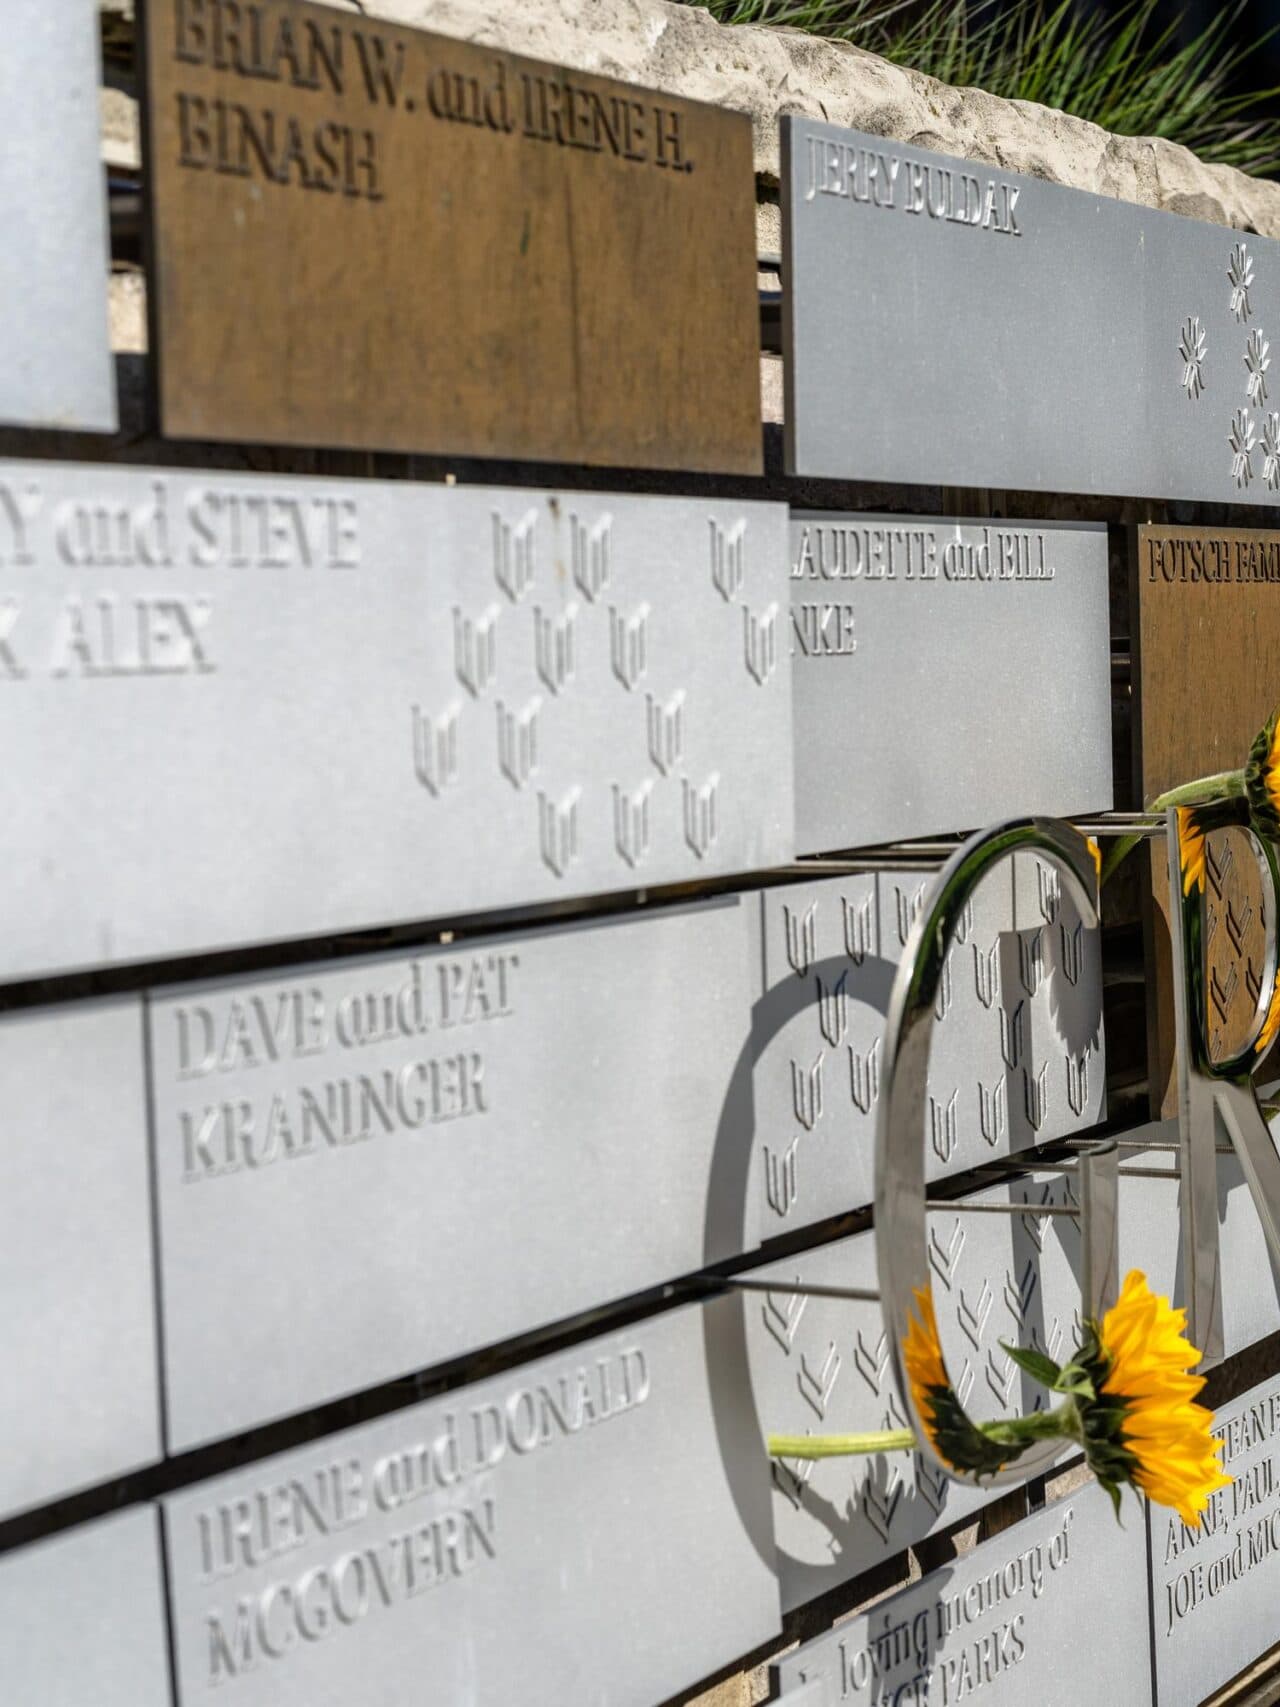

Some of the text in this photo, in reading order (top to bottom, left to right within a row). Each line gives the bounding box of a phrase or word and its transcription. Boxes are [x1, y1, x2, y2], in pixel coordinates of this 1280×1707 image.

[174, 0, 343, 96] BRIAN
[427, 59, 516, 135] and
[520, 72, 647, 163] IRENE
[176, 91, 385, 203] BINASH
[805, 135, 1023, 237] JERRY BULDAK
[55, 480, 174, 568] and
[184, 489, 360, 569] STEVE
[943, 522, 997, 582] and
[997, 533, 1056, 582] BILL
[1147, 538, 1232, 584] FOTSCH
[50, 592, 217, 680] ALEX
[174, 954, 520, 1082] DAVE and PAT
[179, 1052, 489, 1185] KRANINGER
[195, 1346, 652, 1588] IRENE and DONALD
[1163, 1490, 1230, 1566] ANNE,
[1165, 1560, 1205, 1637] JOE
[1207, 1528, 1245, 1599] and
[202, 1497, 497, 1689] MCGOVERN
[839, 1502, 1074, 1699] loving memory of
[940, 1612, 1026, 1707] PARKS
